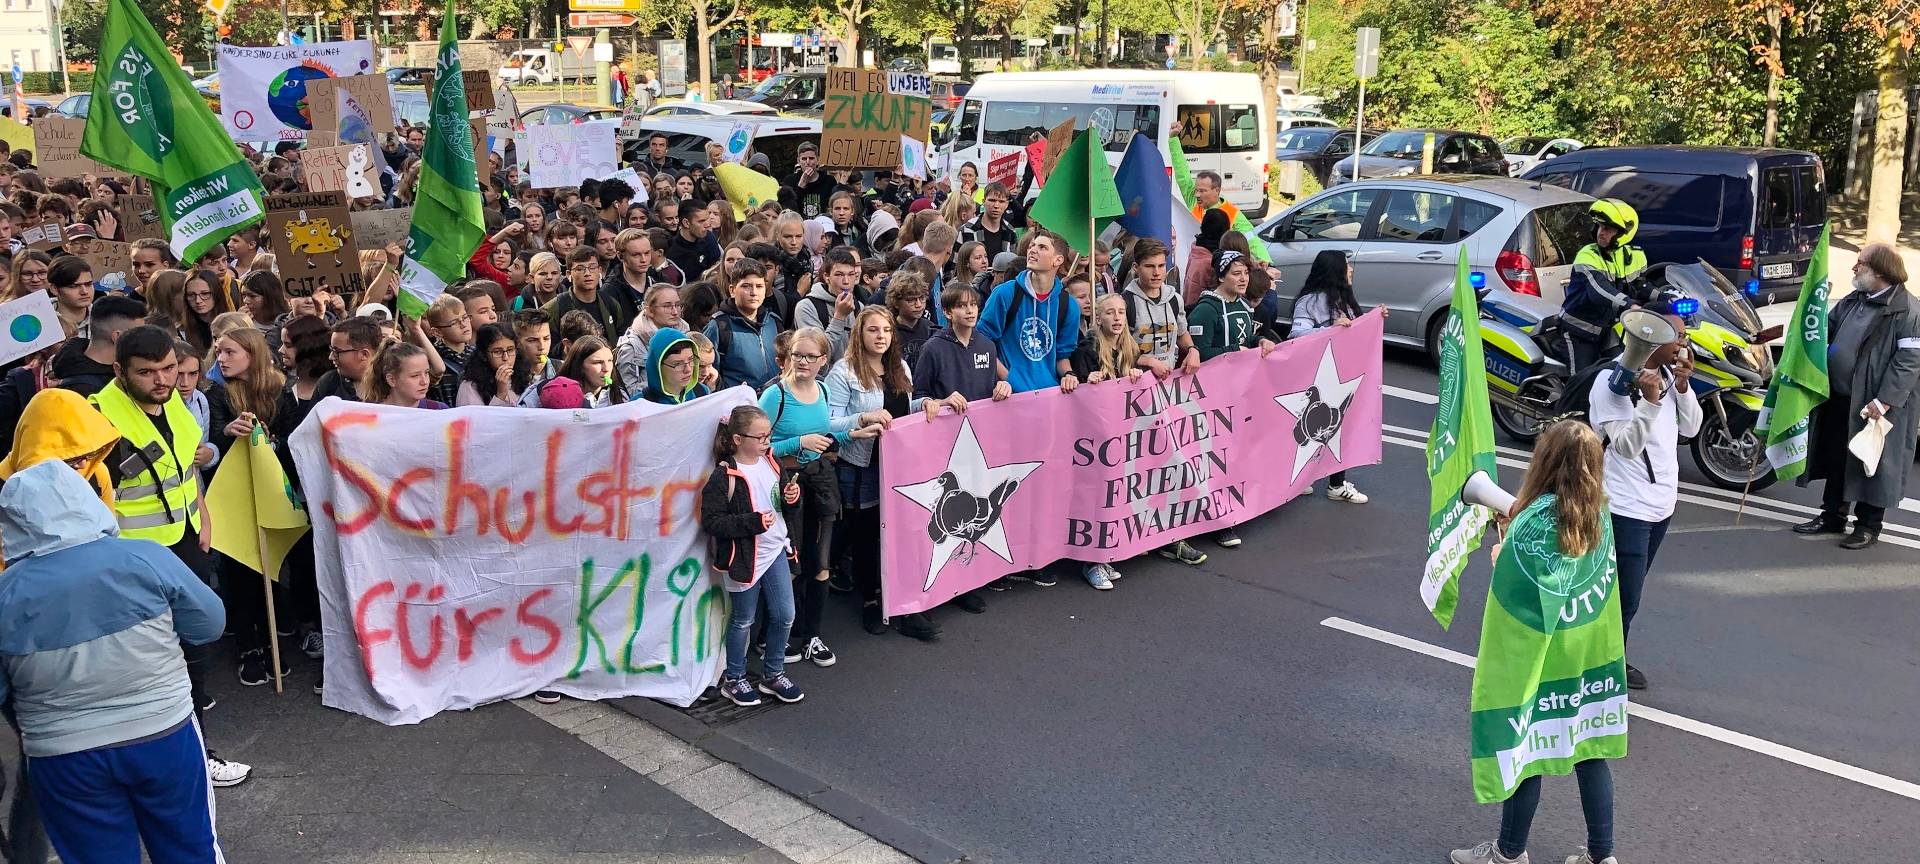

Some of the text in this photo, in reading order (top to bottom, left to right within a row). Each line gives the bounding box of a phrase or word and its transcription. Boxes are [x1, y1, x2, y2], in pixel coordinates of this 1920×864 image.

[254, 49, 272, 59] SIND
[829, 69, 932, 95] WEIL ES UNSERE
[1092, 84, 1124, 95] MediVital
[825, 92, 932, 133] ZUKUNFT
[38, 120, 76, 140] Schule
[303, 148, 340, 169] Rettet
[1485, 356, 1521, 384] OLIZEI
[1072, 405, 1235, 468] SCHÜTZEN
[1101, 447, 1229, 509] FRIEDEN
[1065, 481, 1248, 549] BEWAHREN
[353, 580, 562, 686] fürs
[1538, 676, 1621, 712] streken,
[1528, 729, 1560, 753] Ihr
